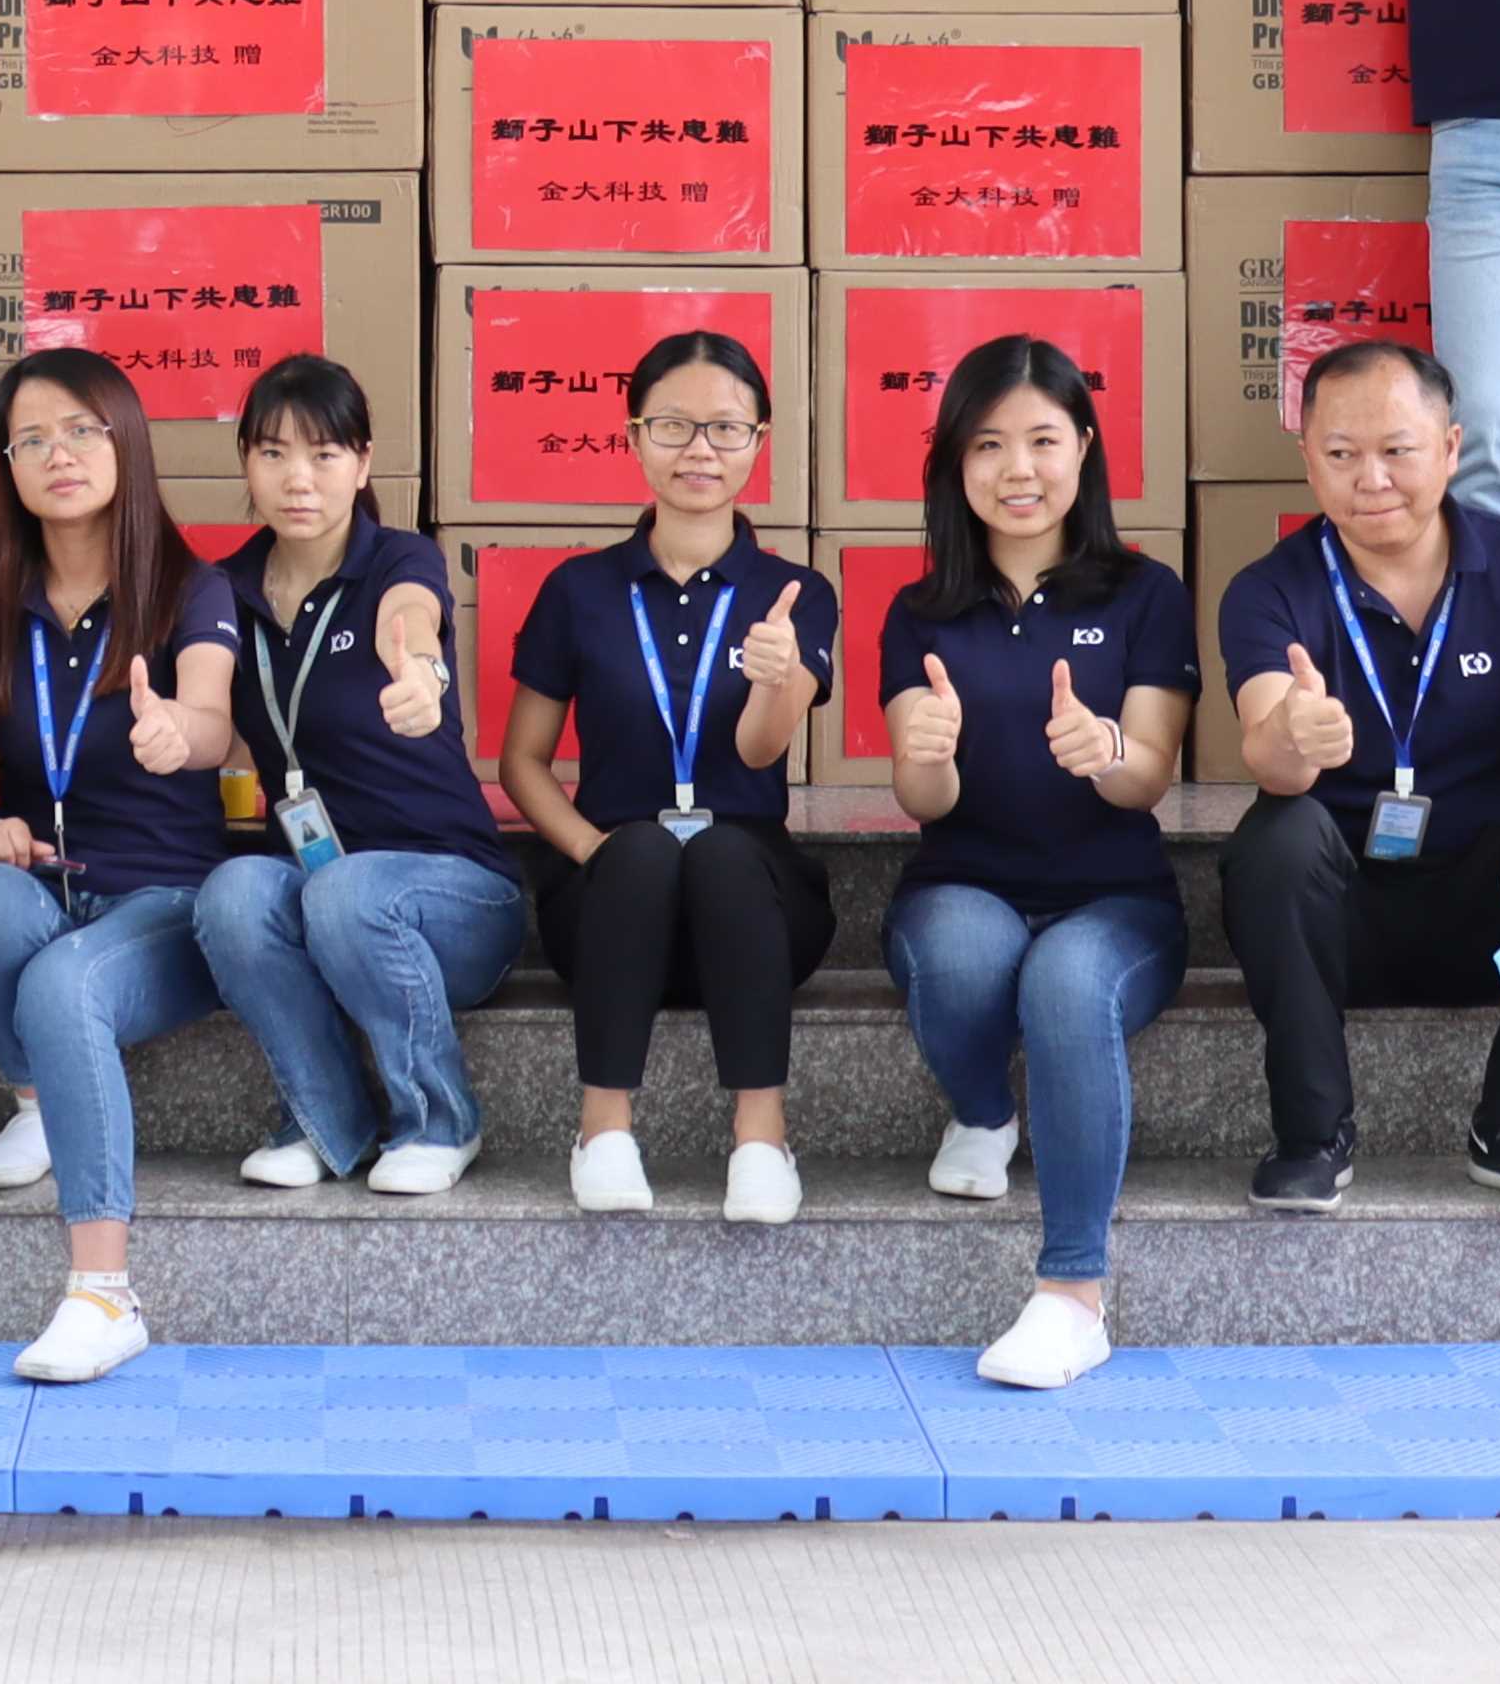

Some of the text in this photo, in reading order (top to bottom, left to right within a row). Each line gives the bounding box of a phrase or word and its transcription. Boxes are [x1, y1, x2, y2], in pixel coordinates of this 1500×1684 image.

[91, 44, 220, 67] 金大科技
[538, 180, 667, 203] 金大科技
[910, 186, 1039, 208] 金大科技
[320, 204, 371, 219] GR100
